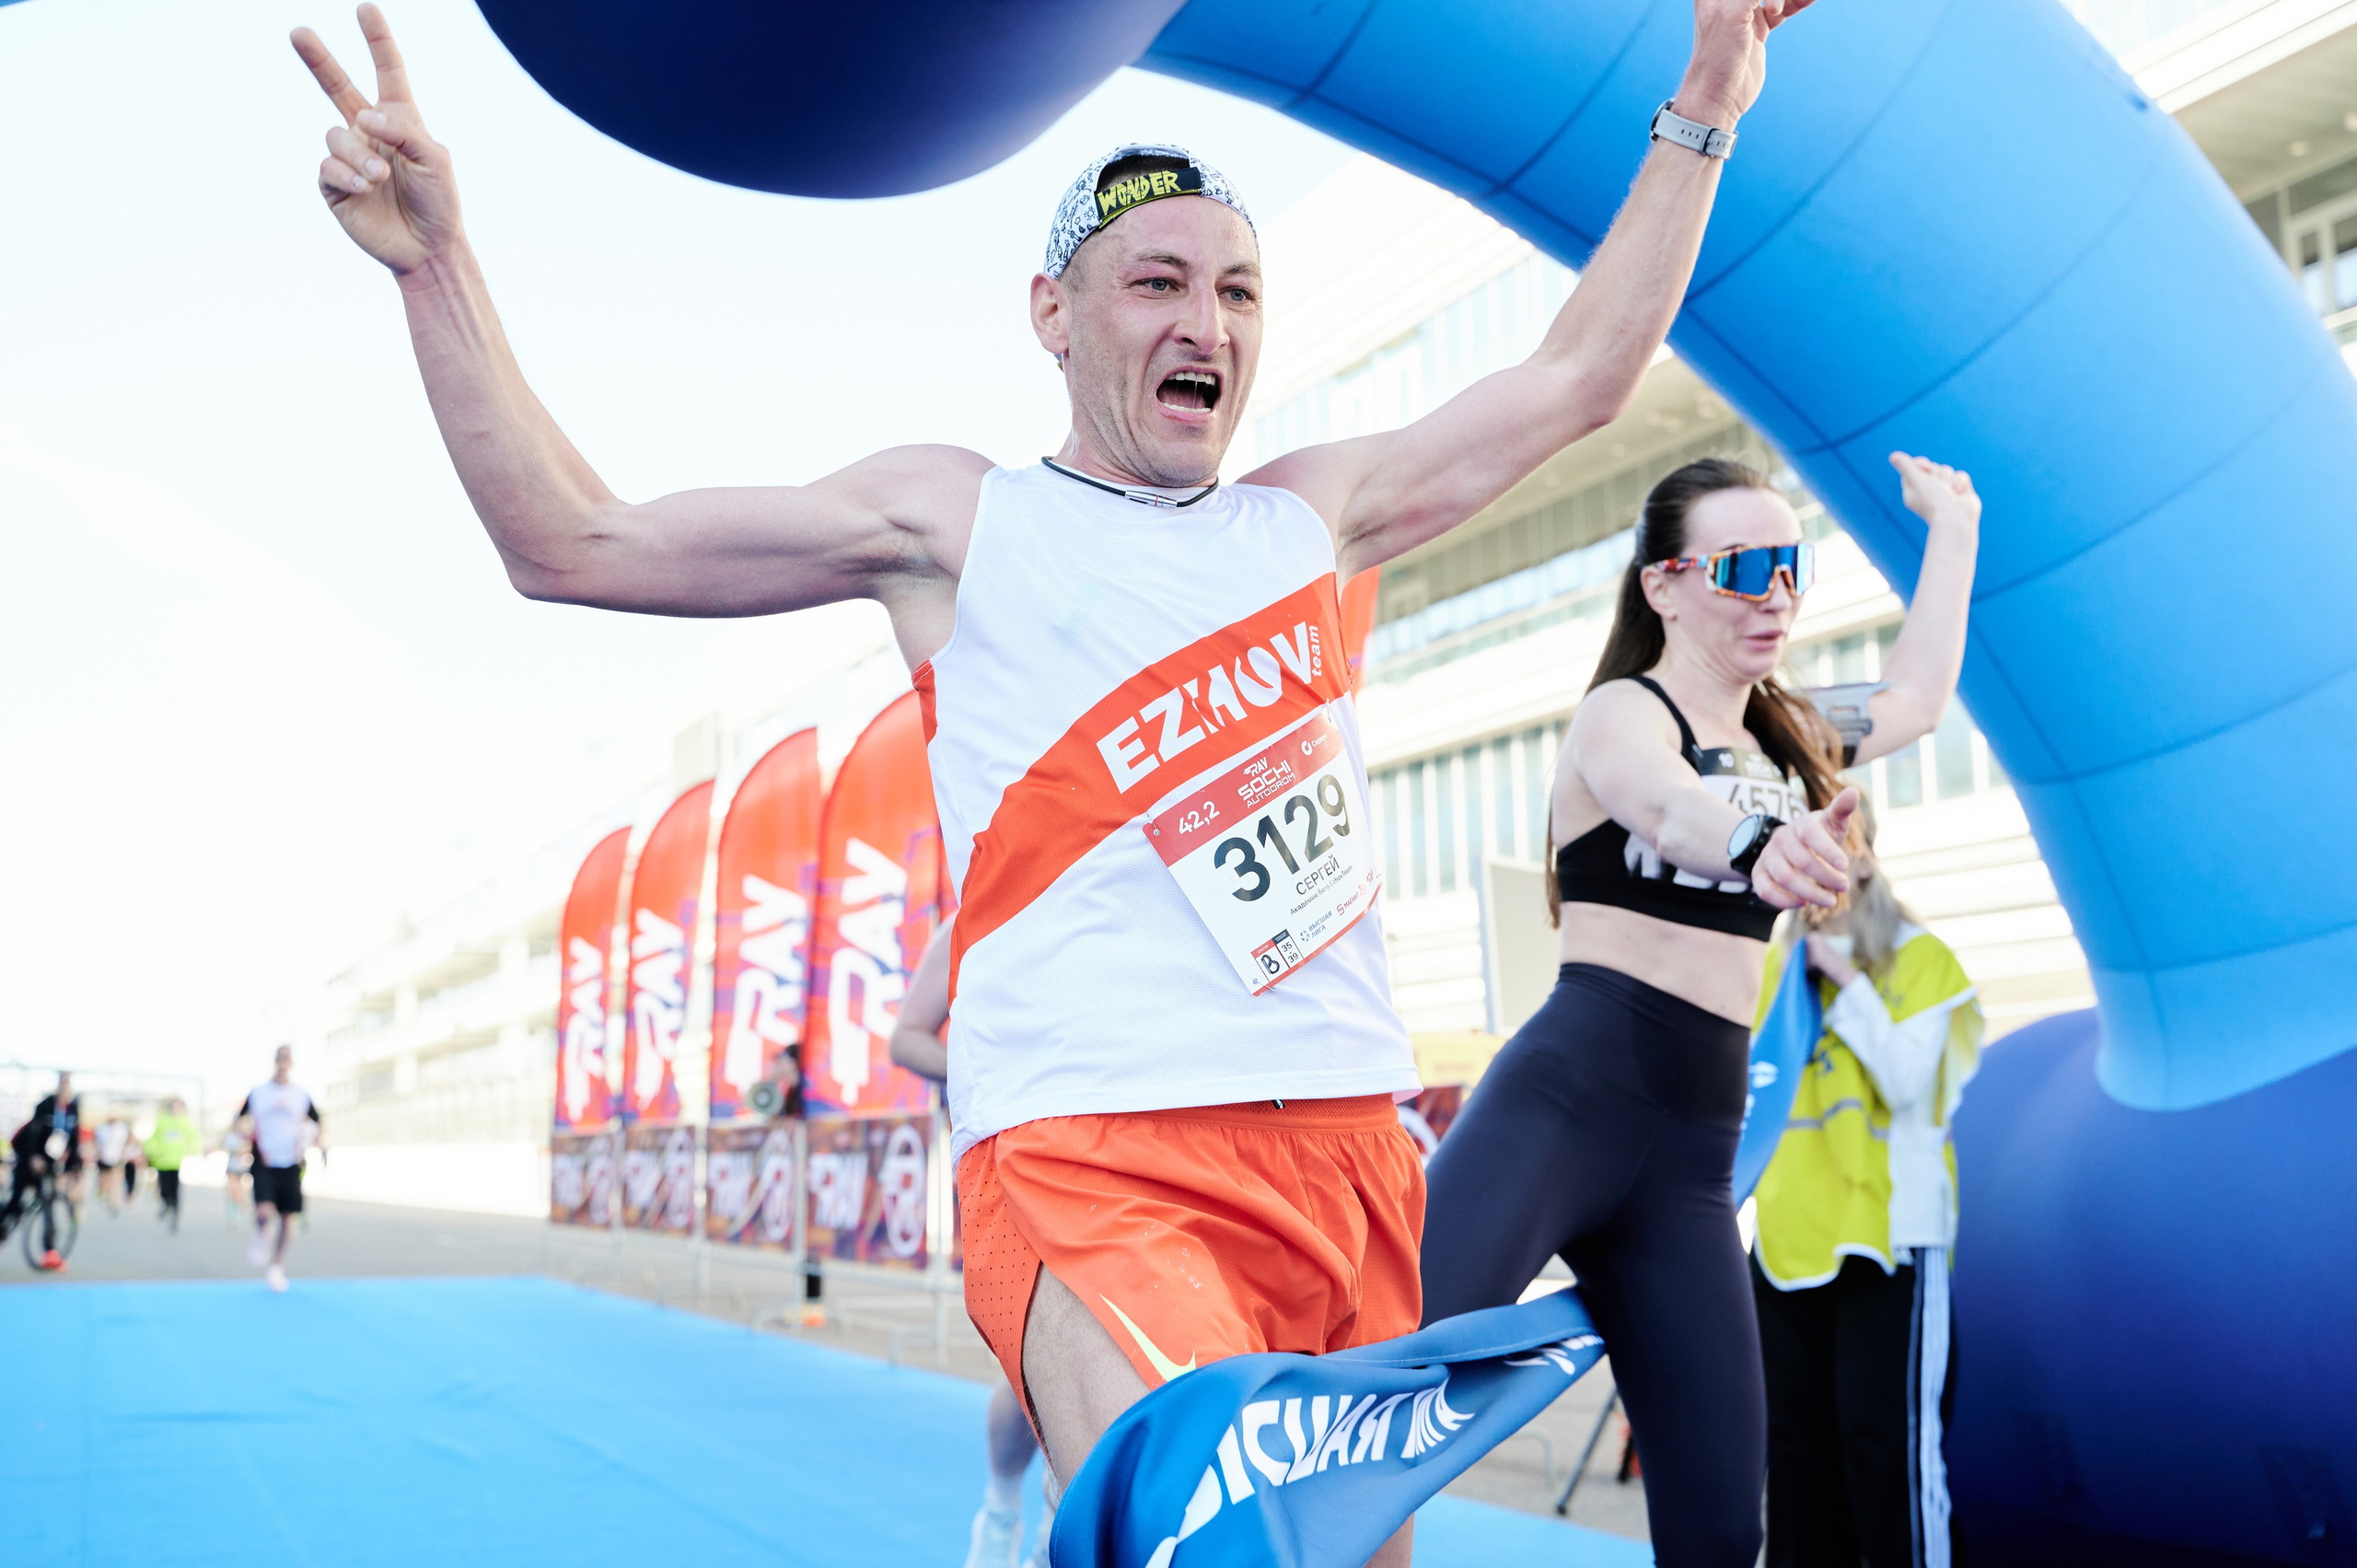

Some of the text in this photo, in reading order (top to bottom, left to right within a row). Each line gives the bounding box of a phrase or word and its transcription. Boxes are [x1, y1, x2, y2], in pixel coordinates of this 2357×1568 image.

[1097, 170, 1181, 215] WONDER
[1308, 625, 1322, 677] team
[1237, 760, 1292, 801] SOCHI
[1247, 772, 1295, 808] AUTODROM
[1178, 800, 1221, 835] 42,2
[1213, 773, 1351, 902] 3129
[1295, 854, 1340, 895] СЕРГЕЙ
[1290, 893, 1318, 915] Академия
[1343, 891, 1359, 909] МАГНИТ
[1308, 911, 1332, 932] ВЫСШАЯ
[1311, 924, 1326, 938] ЛИГА
[1281, 941, 1293, 953] 35
[1287, 952, 1299, 963] 39
[1145, 1392, 1414, 1568] ЫСШАЯ
